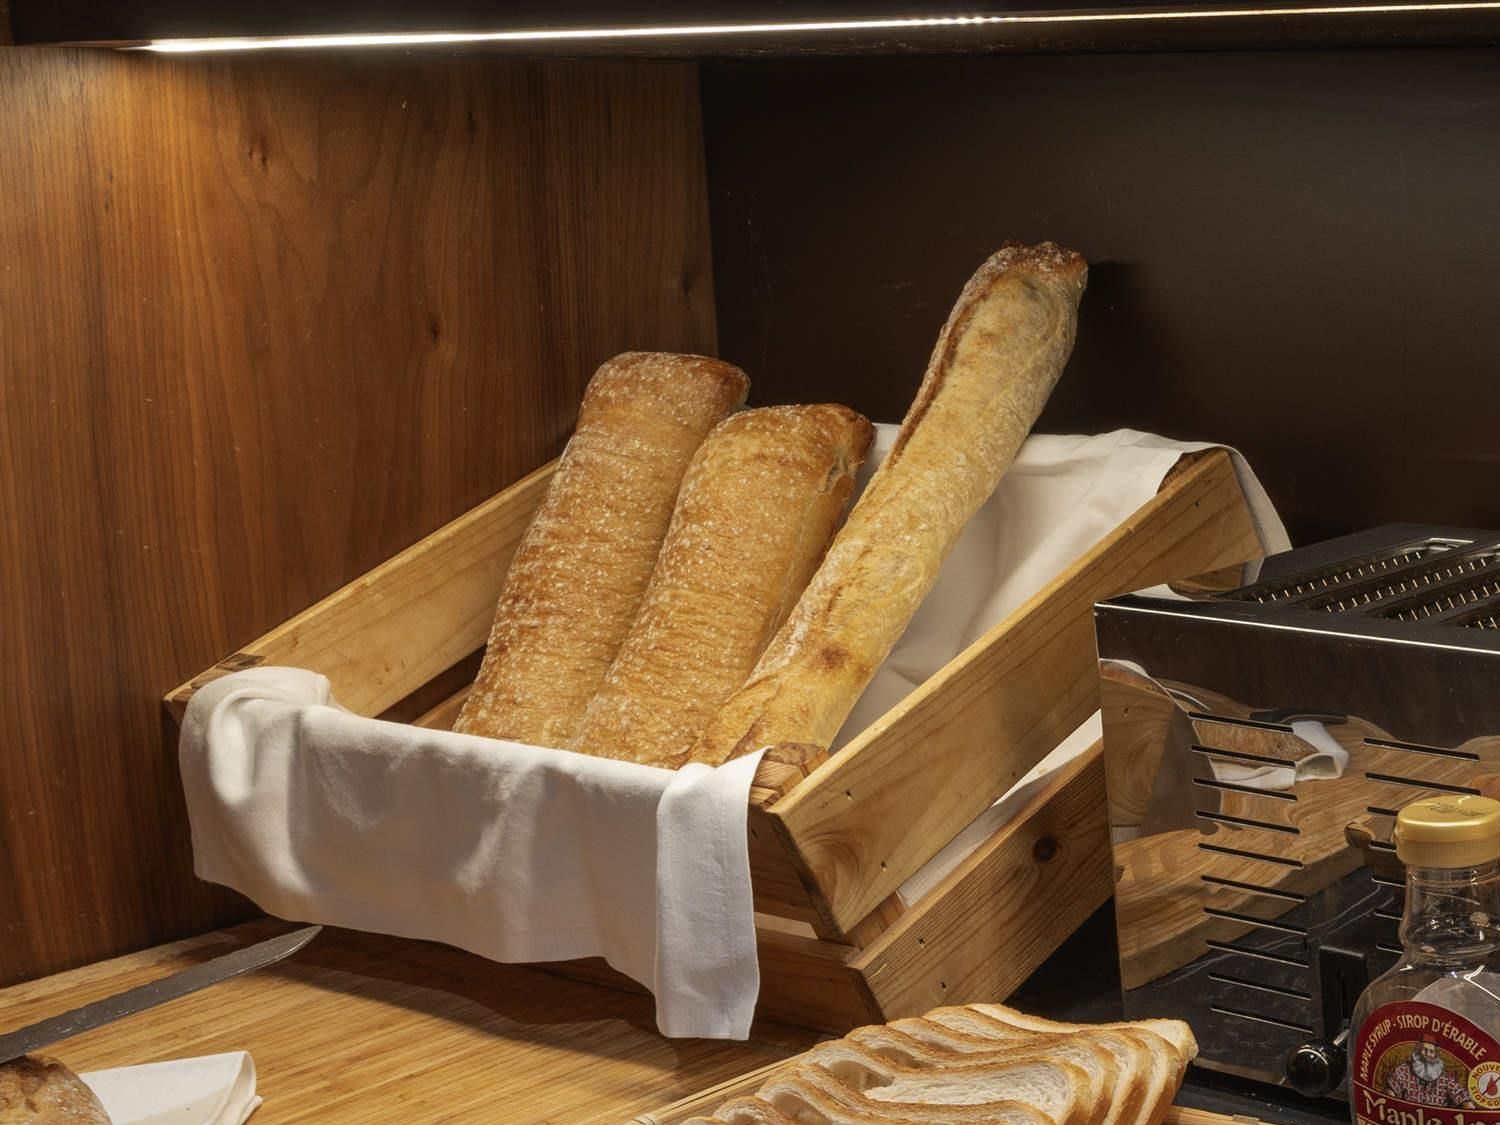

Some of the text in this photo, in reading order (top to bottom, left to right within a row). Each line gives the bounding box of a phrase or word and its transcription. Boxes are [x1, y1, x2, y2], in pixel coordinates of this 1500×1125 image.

[1359, 1040, 1376, 1082] MAPLE
[1368, 1019, 1391, 1048] SYRUP
[1396, 1014, 1430, 1030] SIROP
[1431, 1018, 1488, 1061] D'ÉRABLE
[1470, 1086, 1487, 1104] STOP
